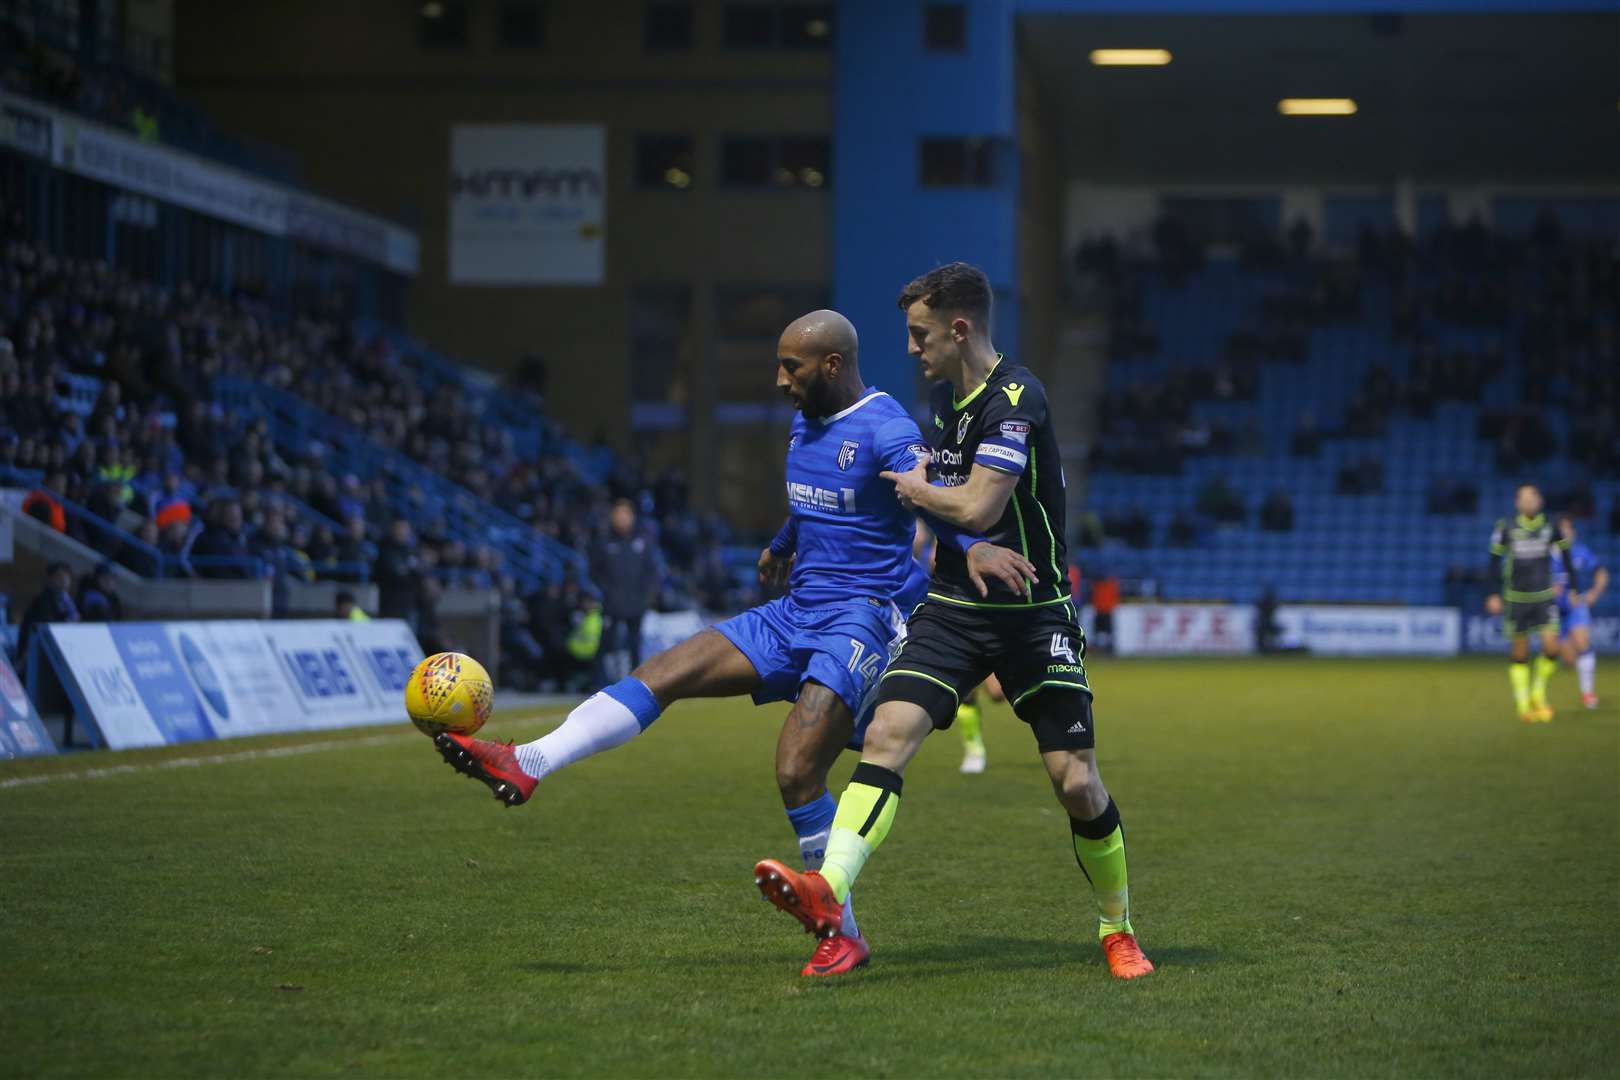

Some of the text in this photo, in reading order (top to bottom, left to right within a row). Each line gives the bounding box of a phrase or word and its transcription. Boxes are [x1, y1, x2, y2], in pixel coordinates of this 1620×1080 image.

[987, 446, 1014, 459] CAPTAIN
[1050, 632, 1076, 663] 4
[1047, 664, 1084, 675] macron
